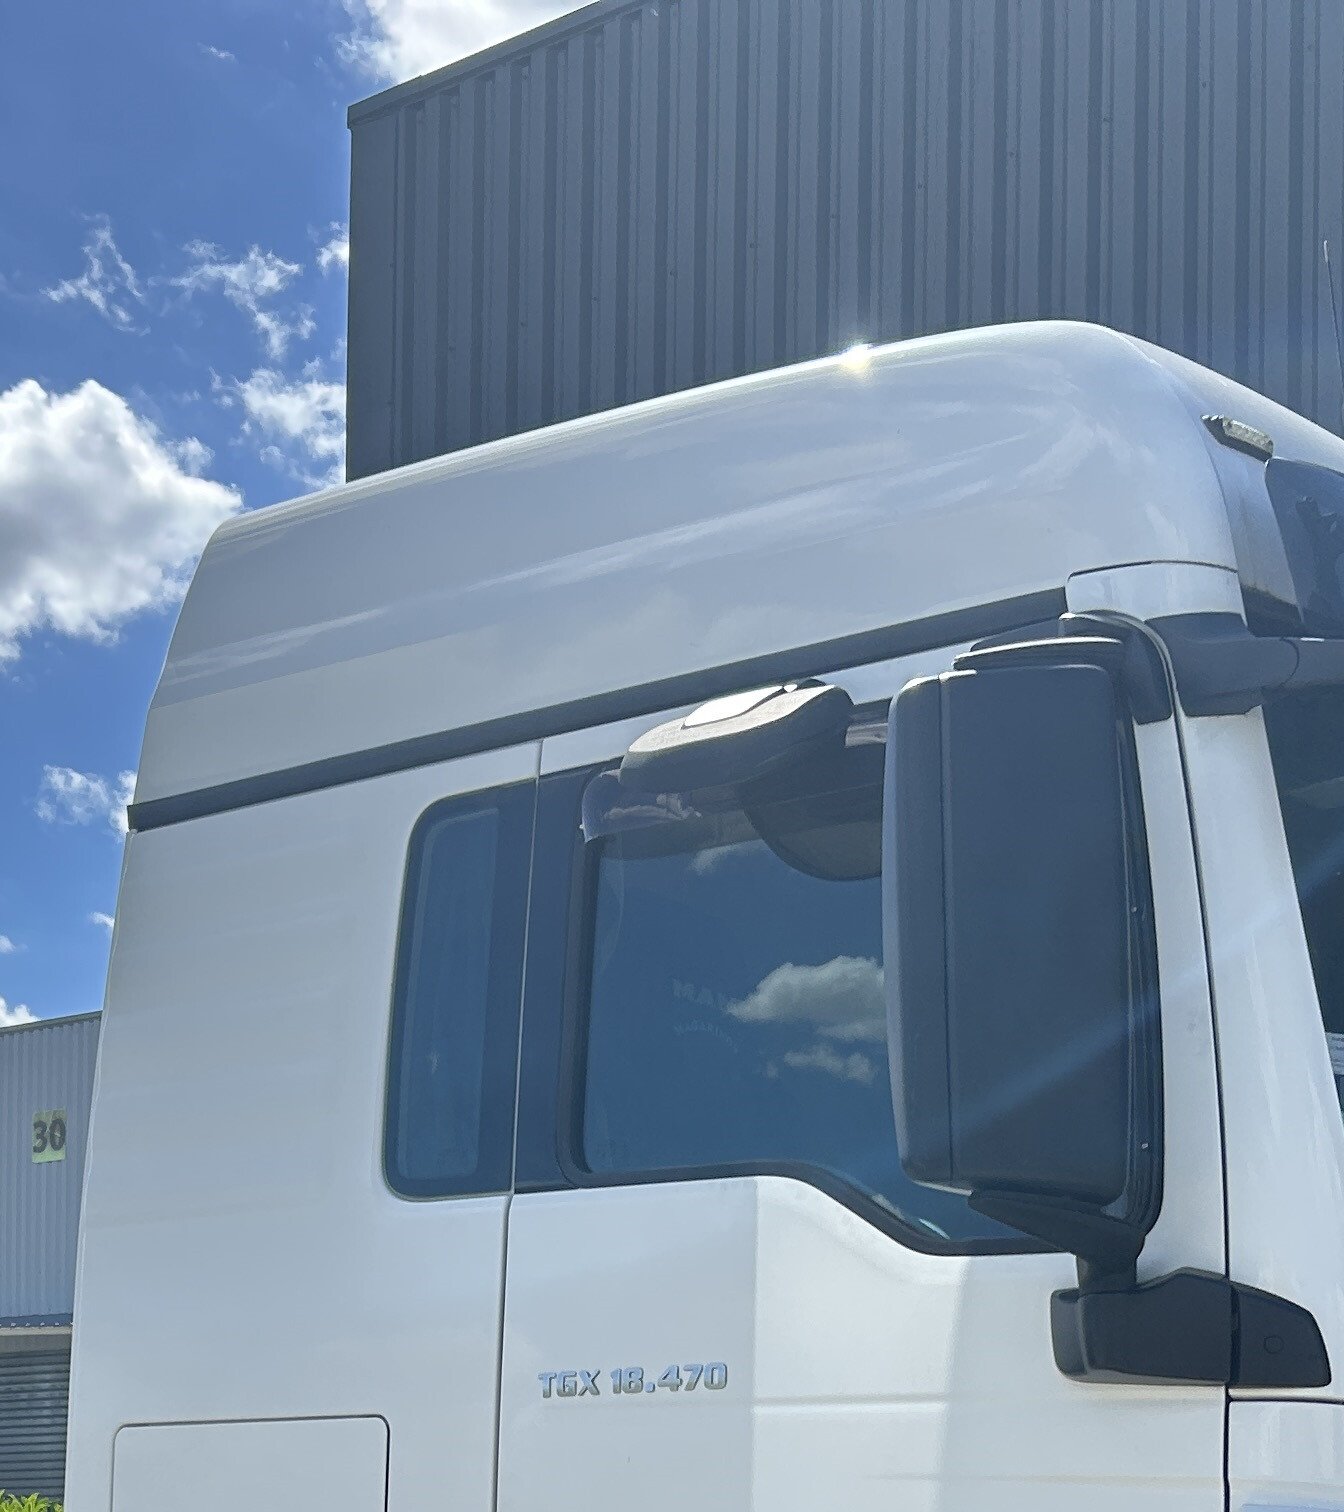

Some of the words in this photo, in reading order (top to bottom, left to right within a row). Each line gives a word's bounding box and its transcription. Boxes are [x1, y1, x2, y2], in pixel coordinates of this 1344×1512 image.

[33, 1118, 67, 1154] 30
[537, 1368, 601, 1399] TGX
[609, 1361, 729, 1395] 18.470
